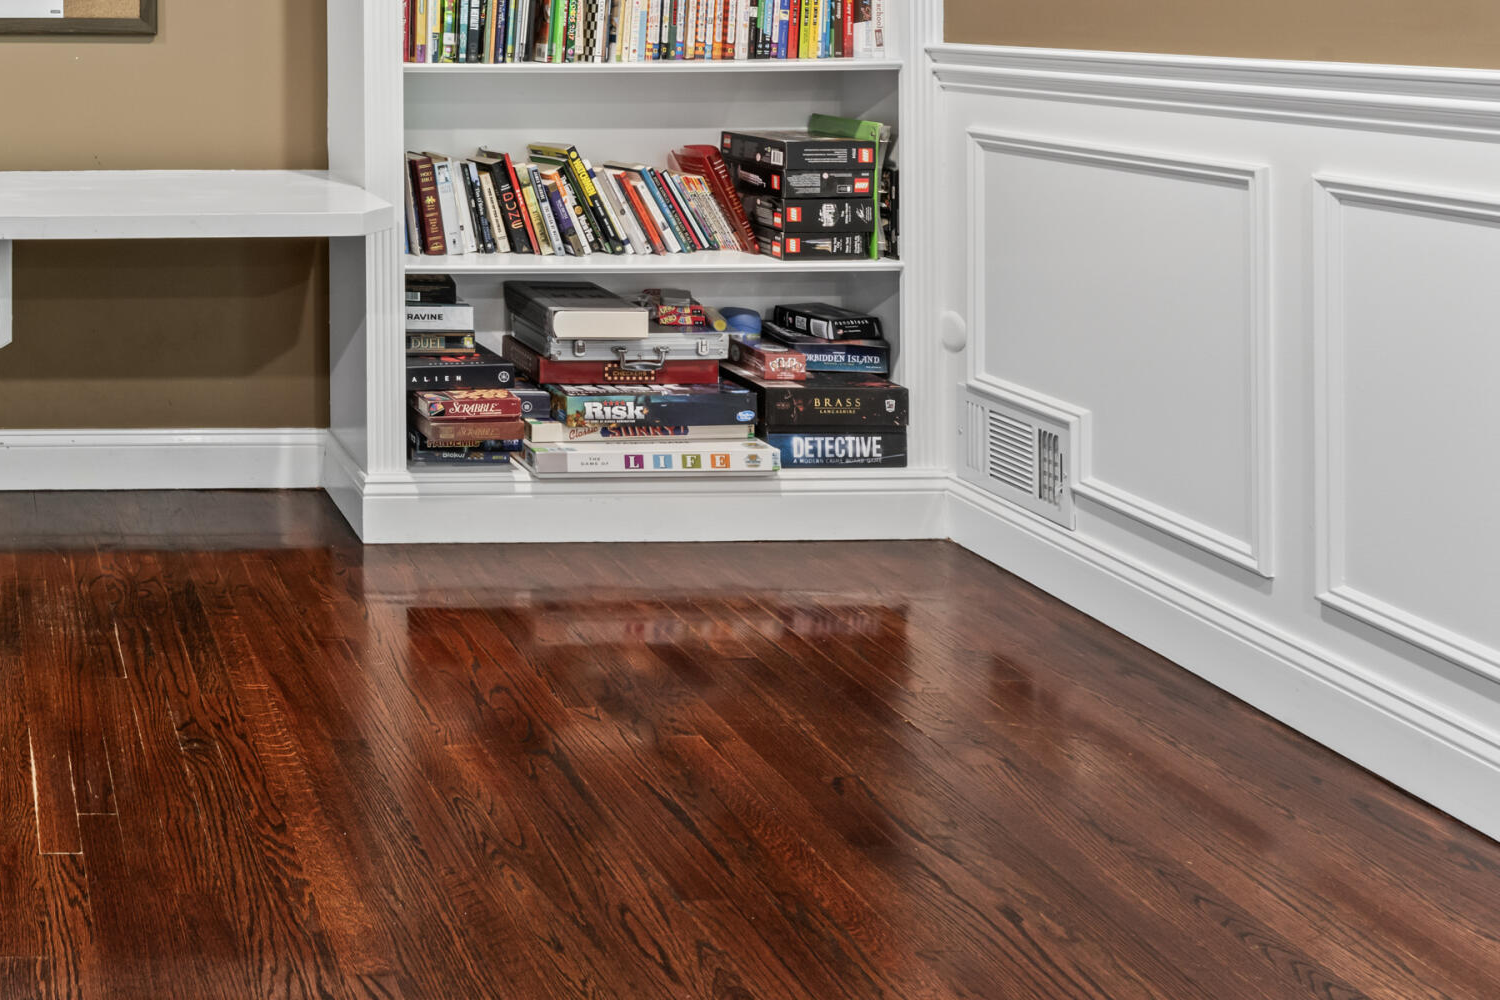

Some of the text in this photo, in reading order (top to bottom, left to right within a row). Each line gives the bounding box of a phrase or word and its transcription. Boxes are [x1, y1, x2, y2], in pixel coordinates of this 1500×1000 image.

[875, 3, 883, 29] school
[533, 172, 541, 184] JAMES
[573, 158, 597, 197] WATCHMEN
[411, 337, 444, 349] DUEL
[806, 353, 880, 364] ORBIDDEN ISLAND
[449, 402, 497, 413] SCRABBLE
[814, 398, 861, 407] BRASS
[569, 426, 599, 440] Classic
[793, 436, 883, 458] DETECTIVE
[442, 451, 465, 459] blokus
